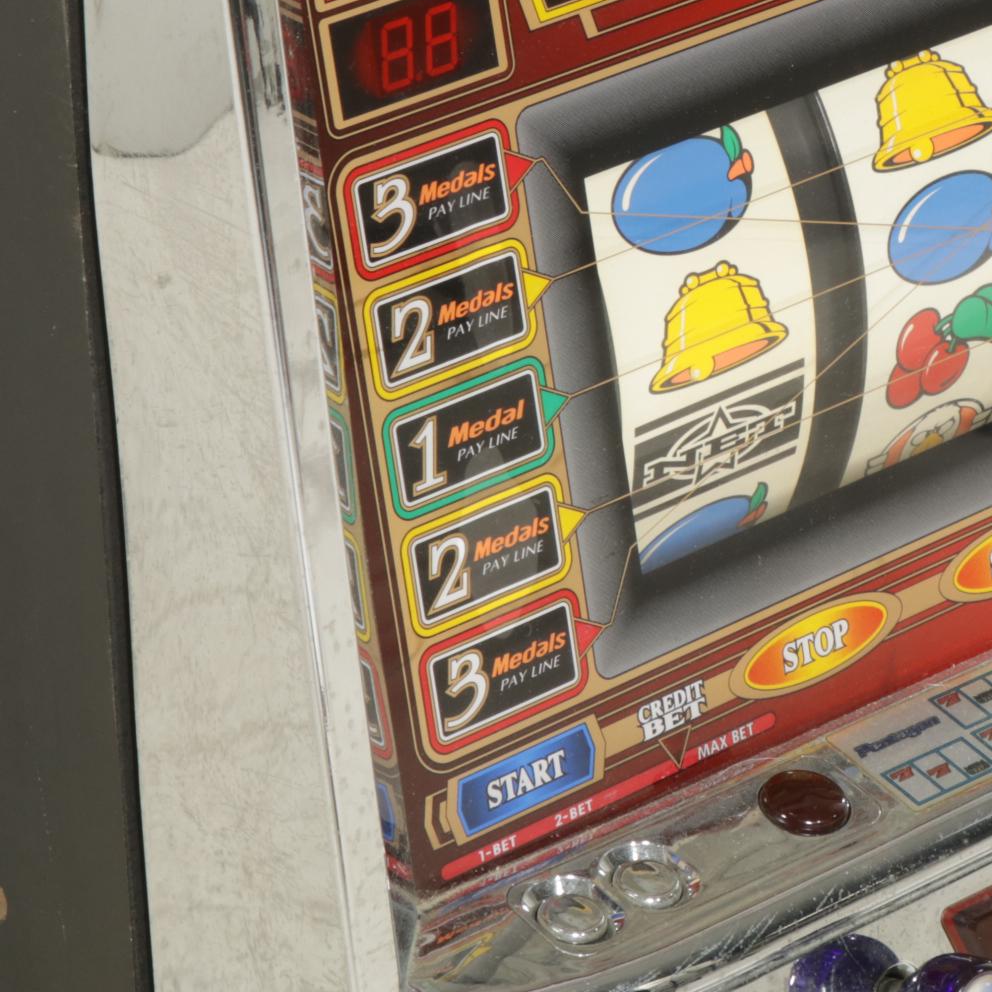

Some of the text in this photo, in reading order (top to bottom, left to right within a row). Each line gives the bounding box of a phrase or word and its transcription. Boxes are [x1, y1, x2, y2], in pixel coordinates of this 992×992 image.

[370, 173, 418, 258] 3
[418, 162, 496, 206] Medals
[427, 186, 492, 221] PAY LINE
[390, 281, 515, 379] 2 Medals
[446, 306, 509, 341] PAY LINE
[408, 398, 526, 497] 1 Medal
[456, 425, 520, 462] PAY LINE
[426, 515, 550, 617] 2 Medals
[482, 540, 545, 577] PAY LINE
[499, 653, 561, 692] PAY LINE
[780, 616, 850, 676] STOP
[444, 629, 567, 731] 3 Medals
[636, 679, 706, 725] CREDIT
[640, 693, 708, 743] BET
[477, 721, 756, 862] 1-BET 2-BET MAX BET
[486, 748, 568, 811] START
